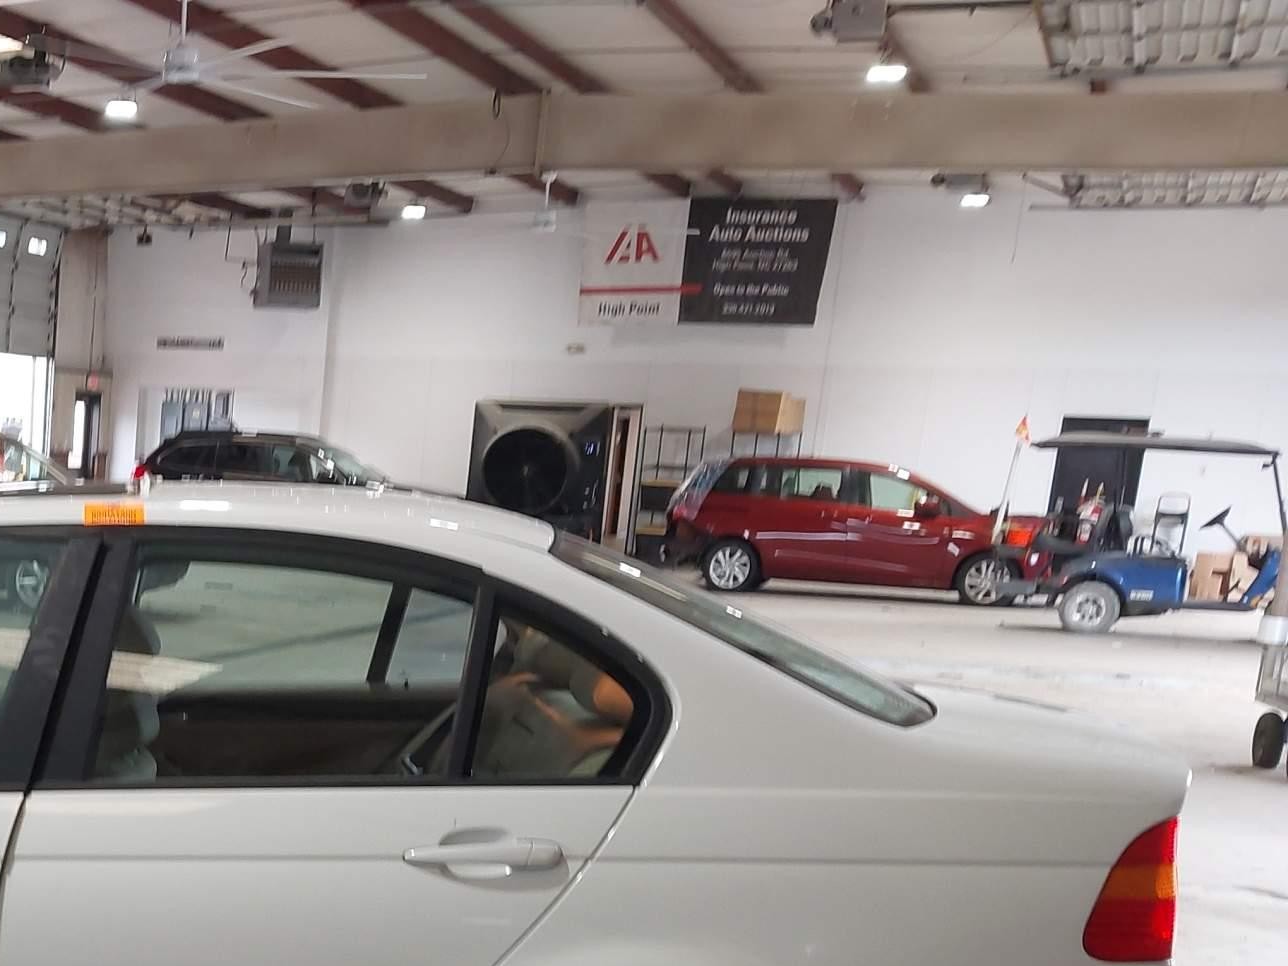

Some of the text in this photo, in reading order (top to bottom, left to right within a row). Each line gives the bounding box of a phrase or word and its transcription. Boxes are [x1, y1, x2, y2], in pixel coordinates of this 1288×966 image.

[725, 206, 799, 225] Insurance
[708, 223, 810, 242] Auto Auctions
[598, 300, 661, 318] High Point
